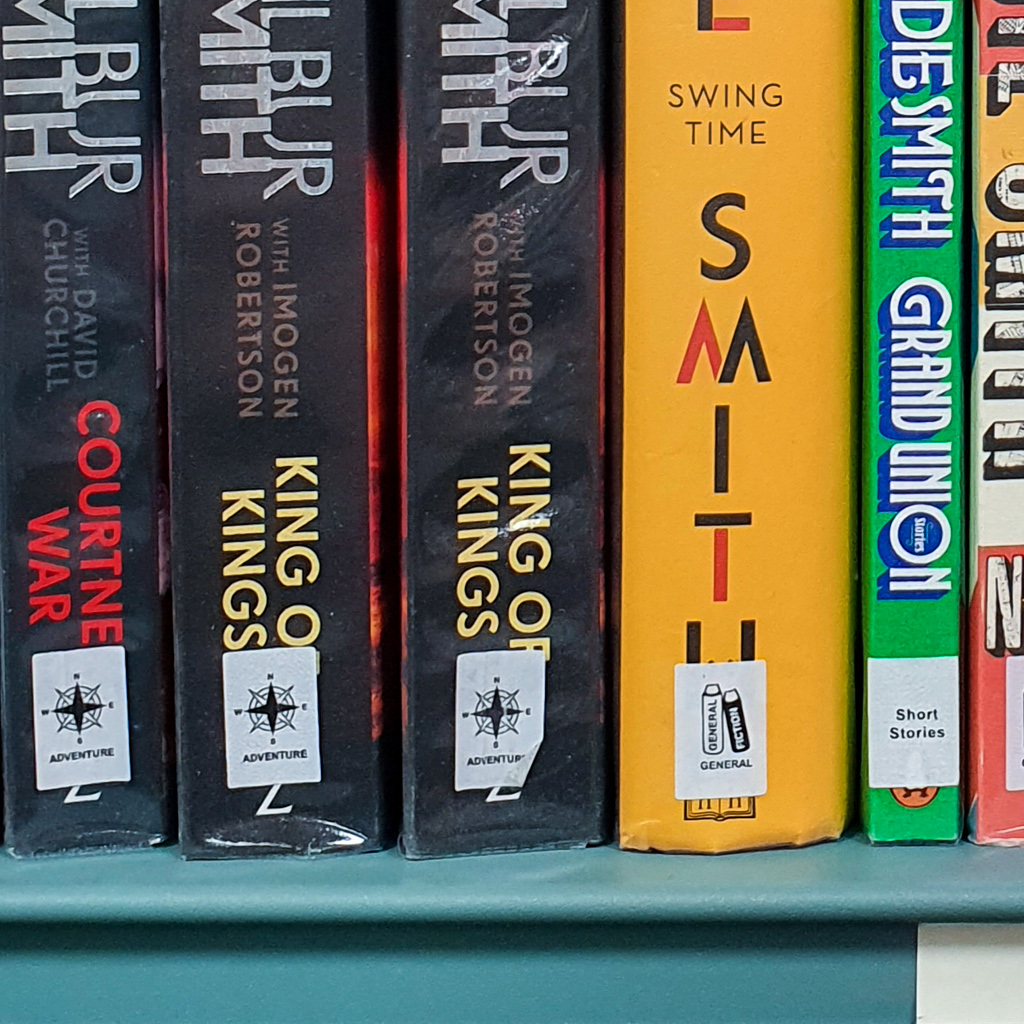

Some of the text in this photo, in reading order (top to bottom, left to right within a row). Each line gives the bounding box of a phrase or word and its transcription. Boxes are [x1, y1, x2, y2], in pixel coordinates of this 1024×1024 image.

[667, 82, 784, 109] SWING
[685, 120, 768, 145] TIME
[885, 95, 955, 242] SMITH
[43, 218, 70, 393] CHURCHILL
[73, 227, 98, 379] WITH DAVID
[235, 222, 264, 418] ROBERTSON
[272, 217, 299, 418] WITH IMOGEN
[473, 211, 498, 406] ROBERTSON
[508, 272, 534, 406] IMOGEN
[884, 275, 953, 436] GRAND
[27, 507, 72, 626] WAR
[76, 400, 124, 645] COURTNE
[221, 488, 268, 651] KINGS
[275, 456, 322, 674] KING O
[456, 476, 500, 639] KINGS
[508, 442, 552, 574] KING
[884, 441, 953, 593] UNION
[914, 517, 927, 553] Stories
[49, 748, 115, 764] ADVENTURE
[242, 749, 308, 764] ADVENTURE
[466, 754, 526, 766] ADVENTUR
[700, 758, 753, 771] GENERAL
[708, 698, 718, 751] GENERAL
[728, 706, 746, 751] FICTION
[889, 724, 946, 740] Stories
[895, 707, 939, 722] Short
